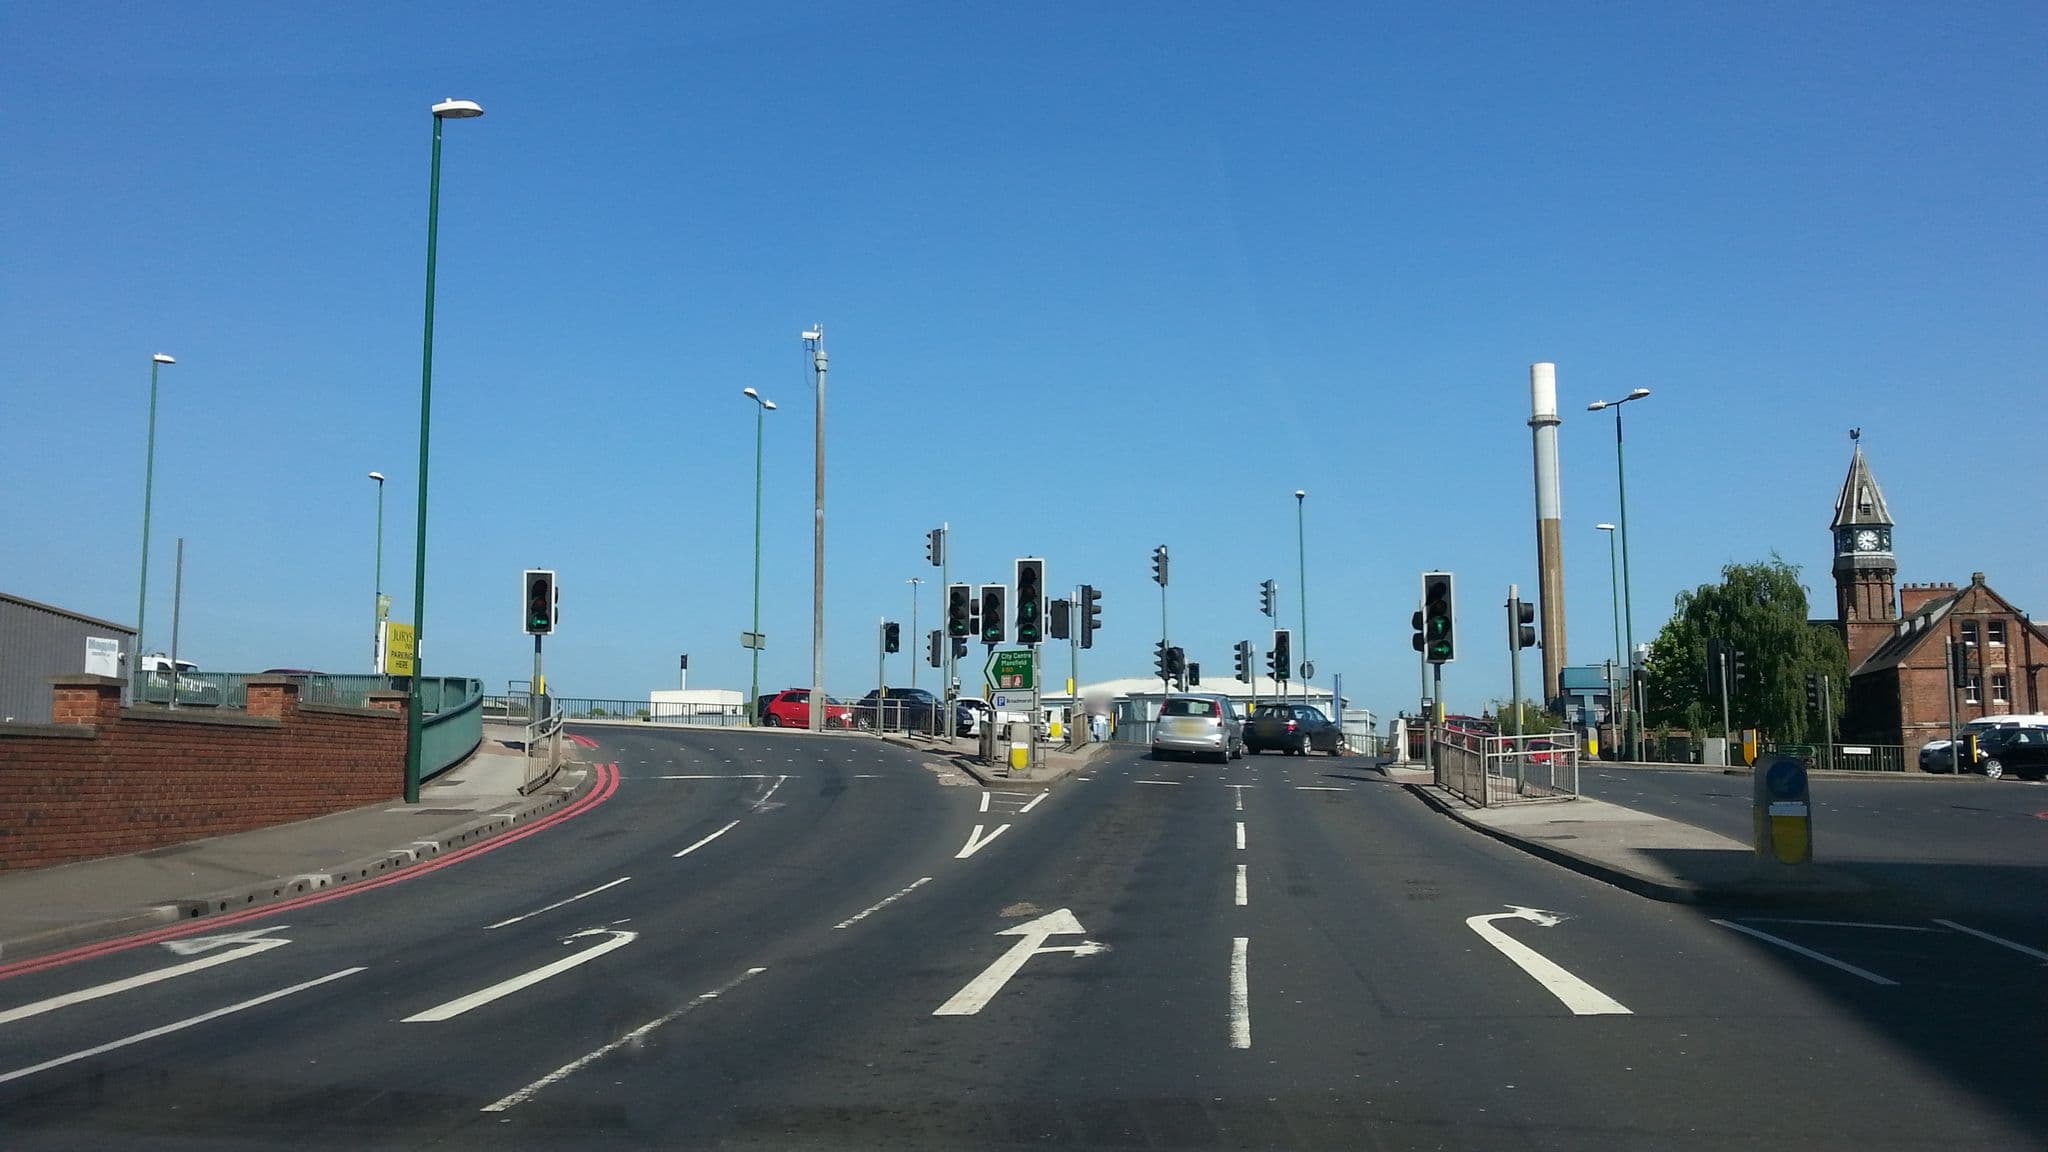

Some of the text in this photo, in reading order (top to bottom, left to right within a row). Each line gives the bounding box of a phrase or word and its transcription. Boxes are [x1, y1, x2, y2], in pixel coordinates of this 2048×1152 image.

[392, 629, 413, 643] JURYS
[391, 650, 413, 660] PARKING
[396, 660, 408, 669] HERE
